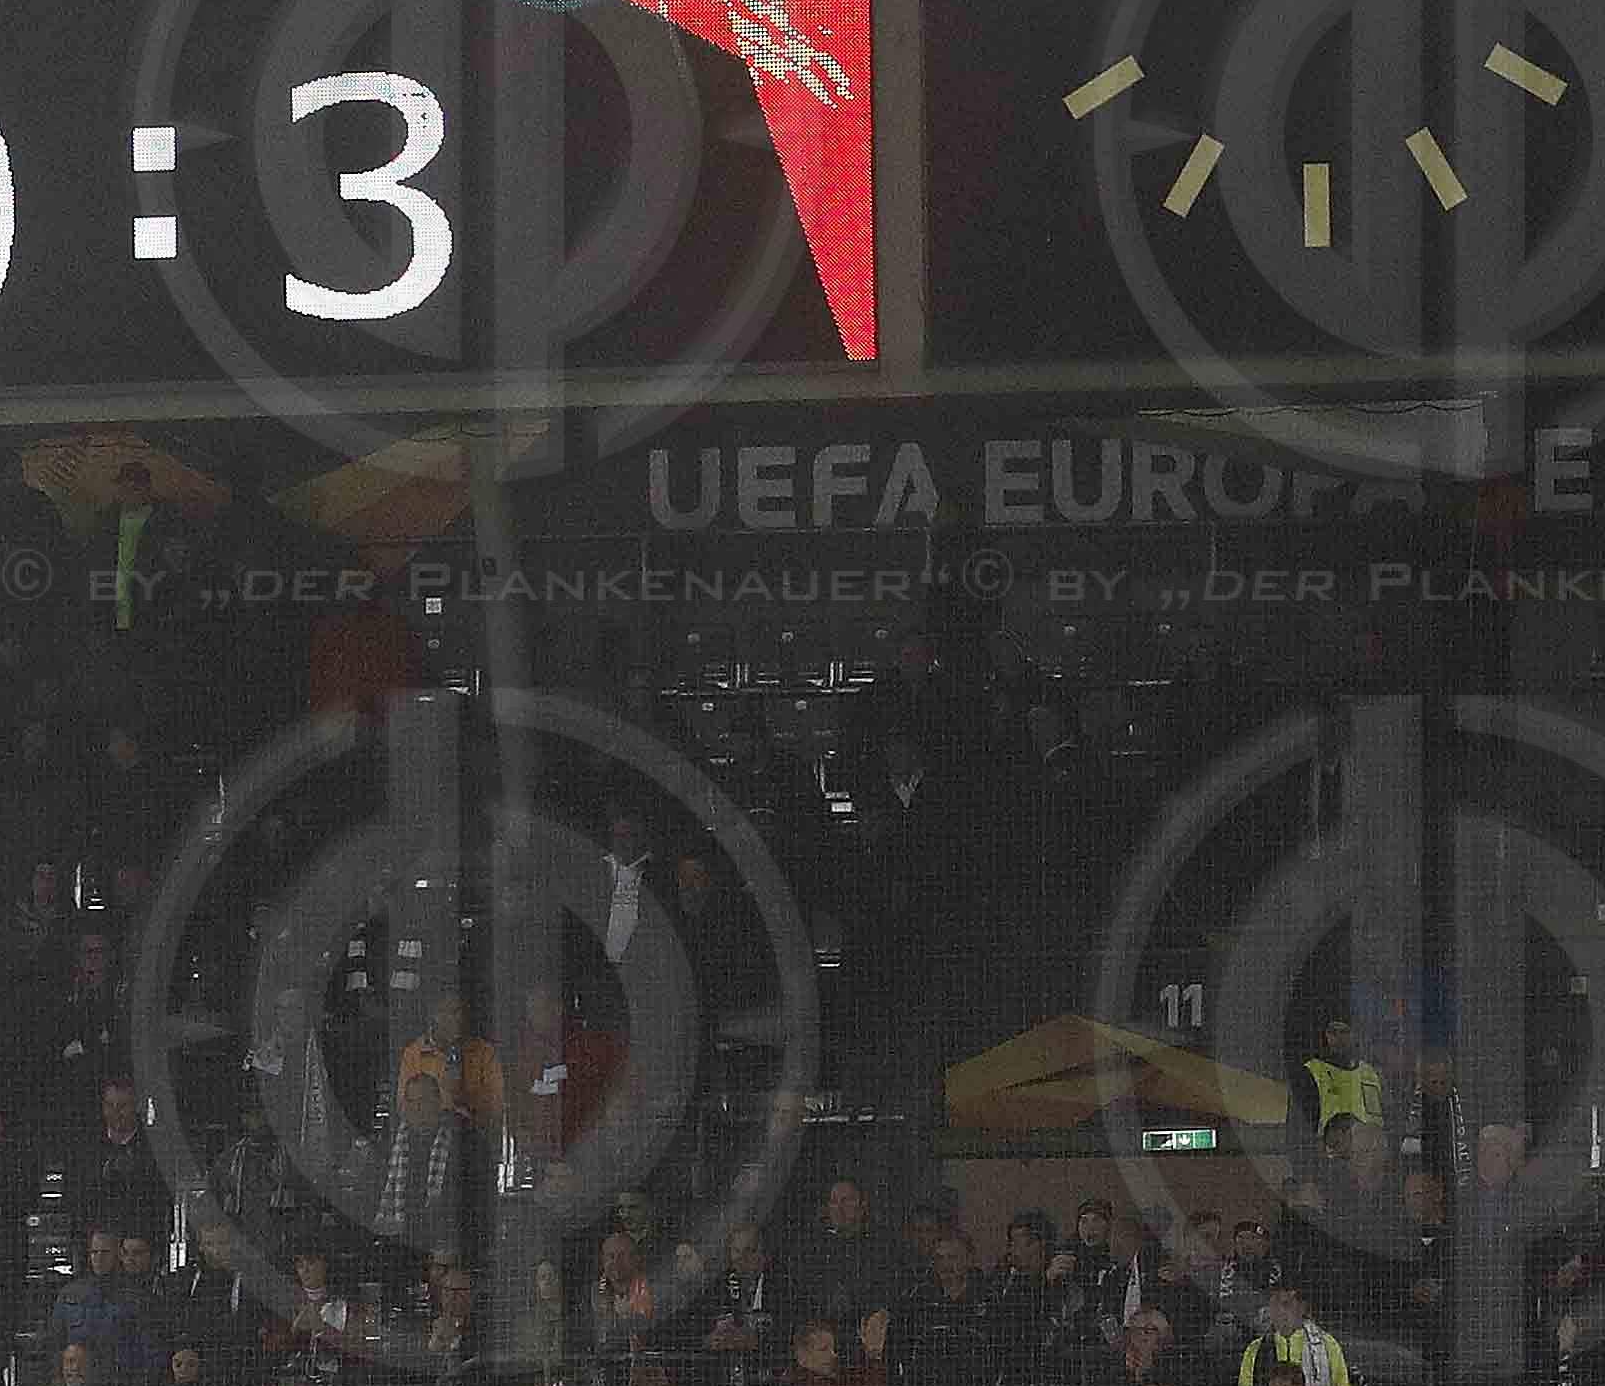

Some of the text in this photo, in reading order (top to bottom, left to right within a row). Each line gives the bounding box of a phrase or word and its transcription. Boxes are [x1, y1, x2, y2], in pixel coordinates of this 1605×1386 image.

[283, 71, 455, 321] 3
[647, 441, 938, 529] UEFA
[1159, 984, 1203, 1028] 11
